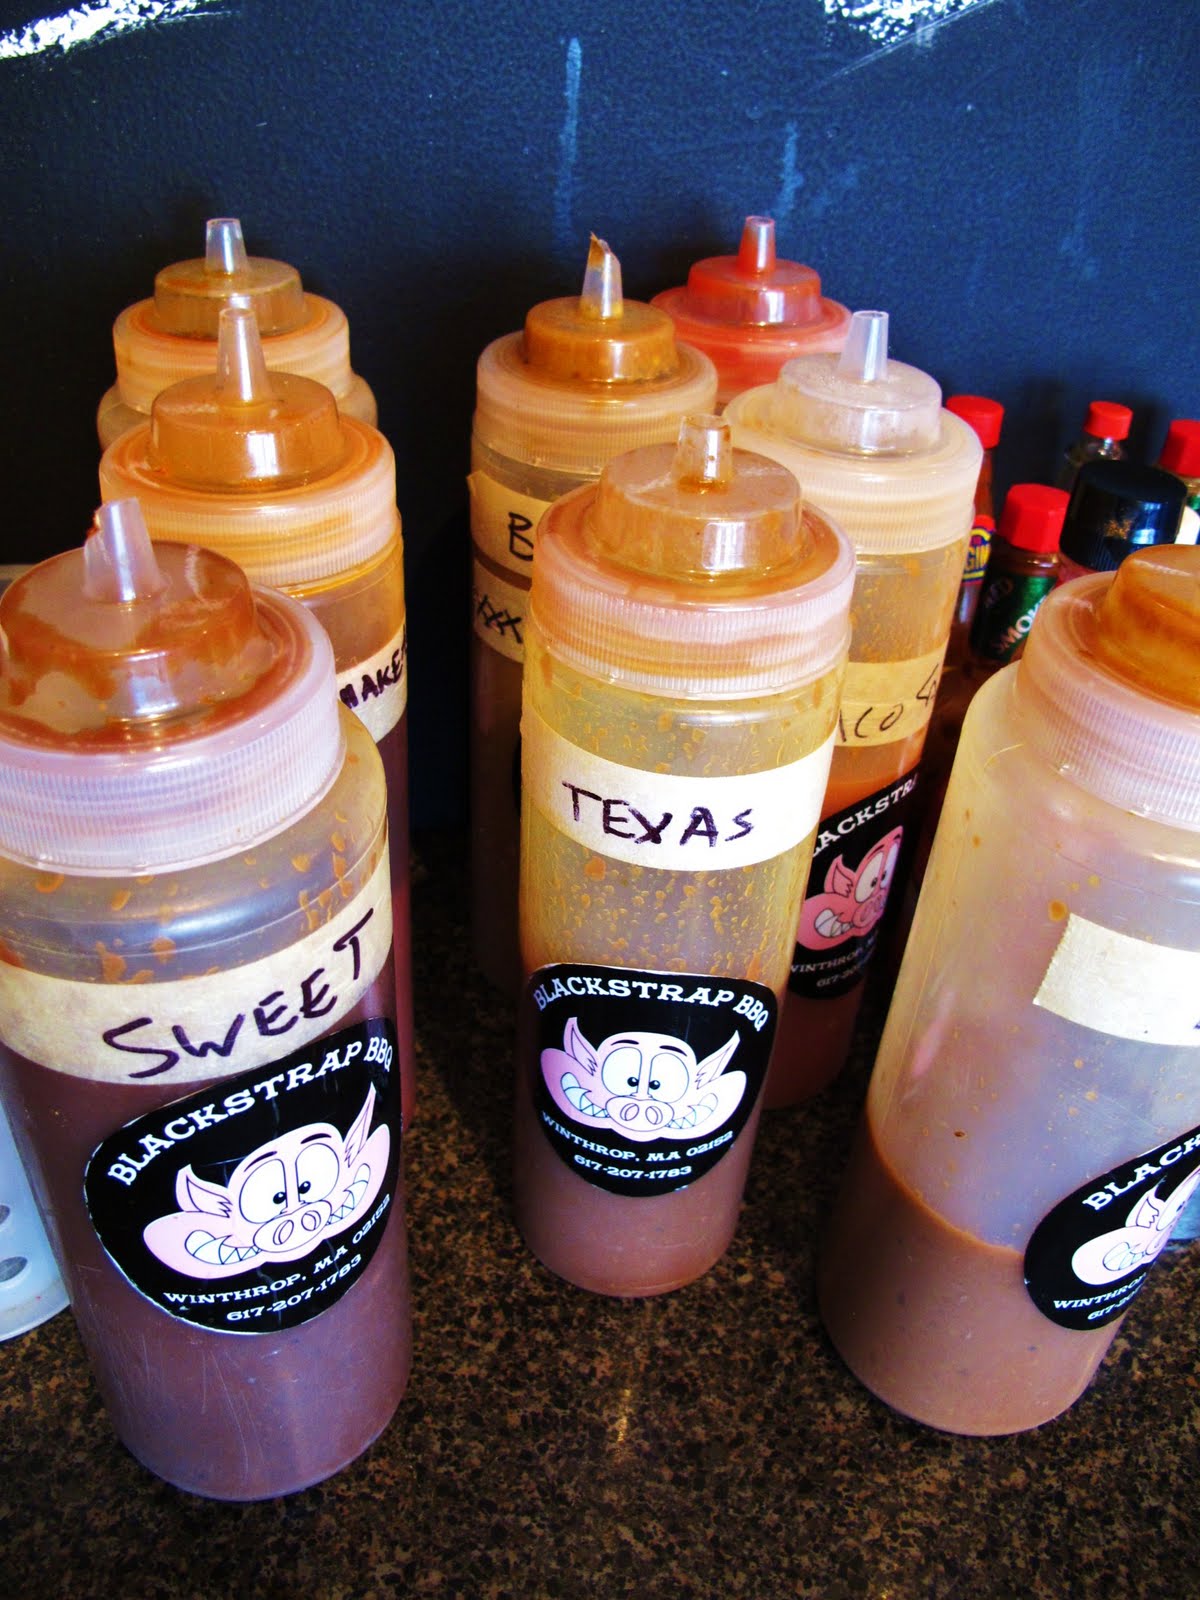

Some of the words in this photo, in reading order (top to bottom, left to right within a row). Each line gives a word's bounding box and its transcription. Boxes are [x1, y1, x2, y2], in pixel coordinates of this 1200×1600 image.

[561, 780, 755, 848] TEXAS
[102, 907, 375, 1079] SWEET
[532, 976, 735, 1012] BLACKSTRAP
[732, 994, 770, 1032] BBQ
[106, 1040, 362, 1187] BLACKSTRAP
[363, 1036, 394, 1073] BBQ
[573, 1153, 693, 1180] 617-207-1783
[645, 1150, 682, 1163] MA
[685, 1130, 734, 1157] 02152
[312, 1244, 349, 1275] MA
[351, 1193, 391, 1245] 02152
[226, 1253, 363, 1322] 617-207-1783
